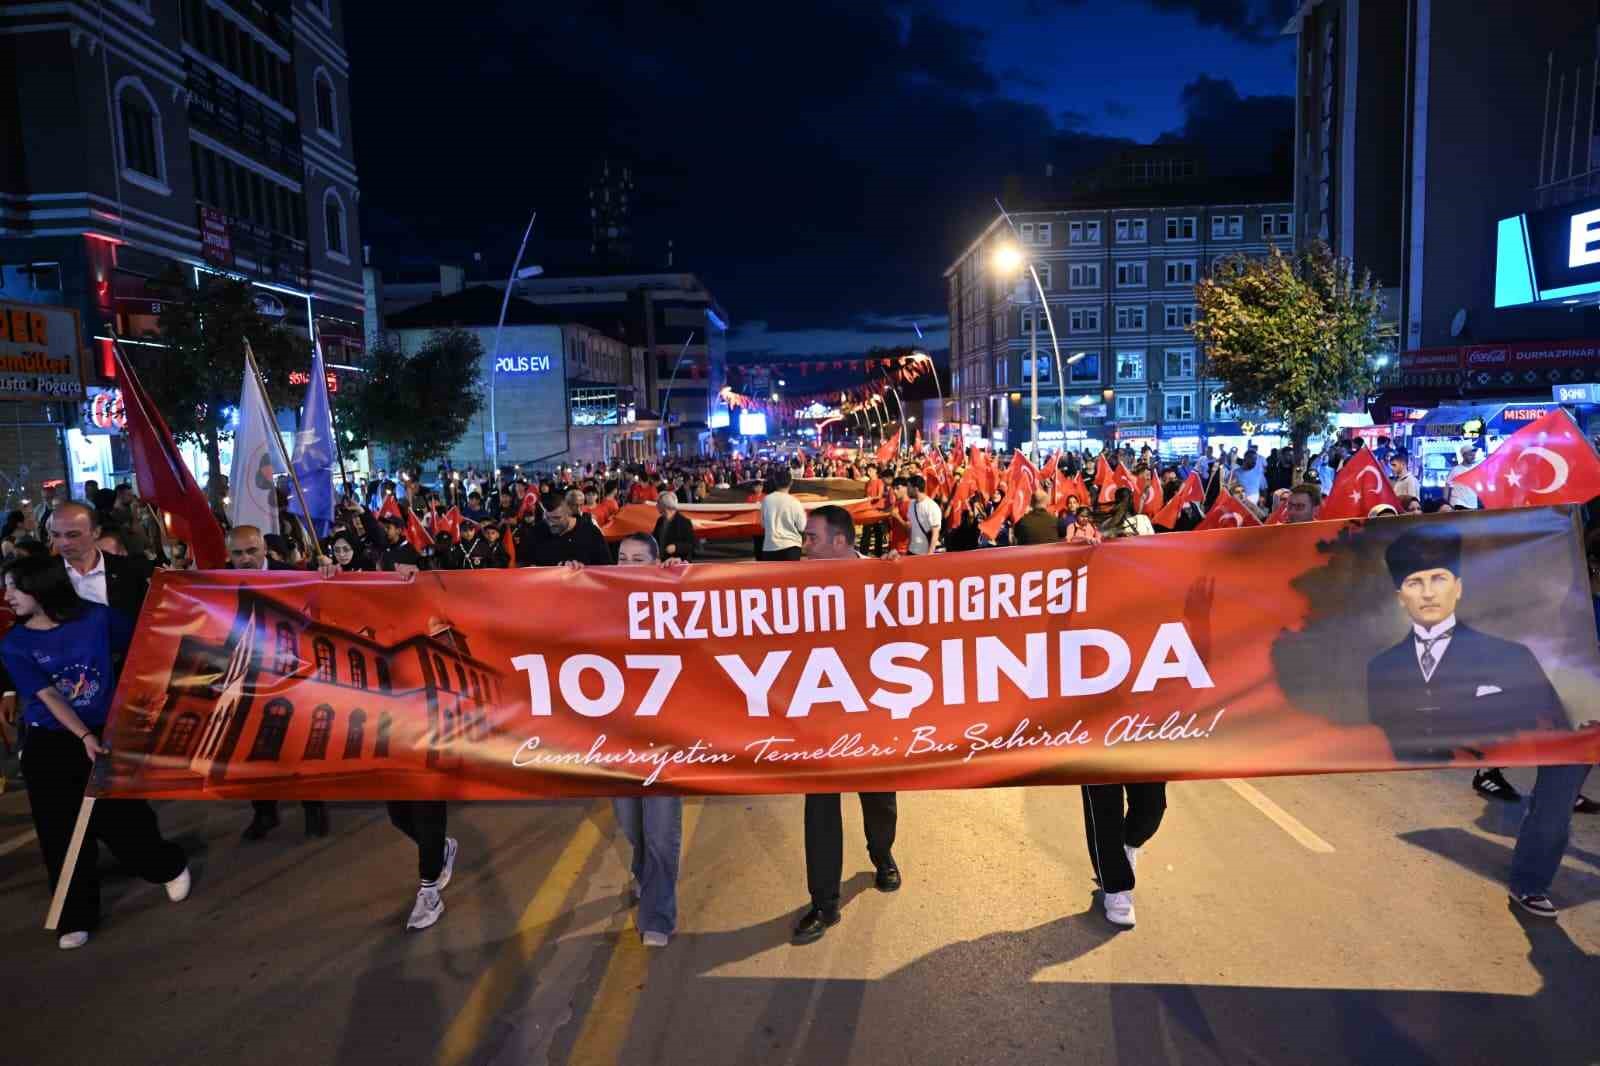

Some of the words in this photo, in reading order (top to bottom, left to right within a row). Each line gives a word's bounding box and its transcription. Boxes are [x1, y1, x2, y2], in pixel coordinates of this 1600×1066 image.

[628, 585, 846, 640] ERZURUM
[864, 565, 1089, 628] KONGRESİ
[511, 653, 682, 717] 107
[714, 621, 1215, 720] YAŞINDA
[512, 735, 735, 786] Cumhuriyetin
[745, 732, 899, 763] Temelleri
[904, 725, 957, 757] Bu
[963, 718, 1091, 763] Şehirde
[1104, 708, 1225, 749] Atıldı!
